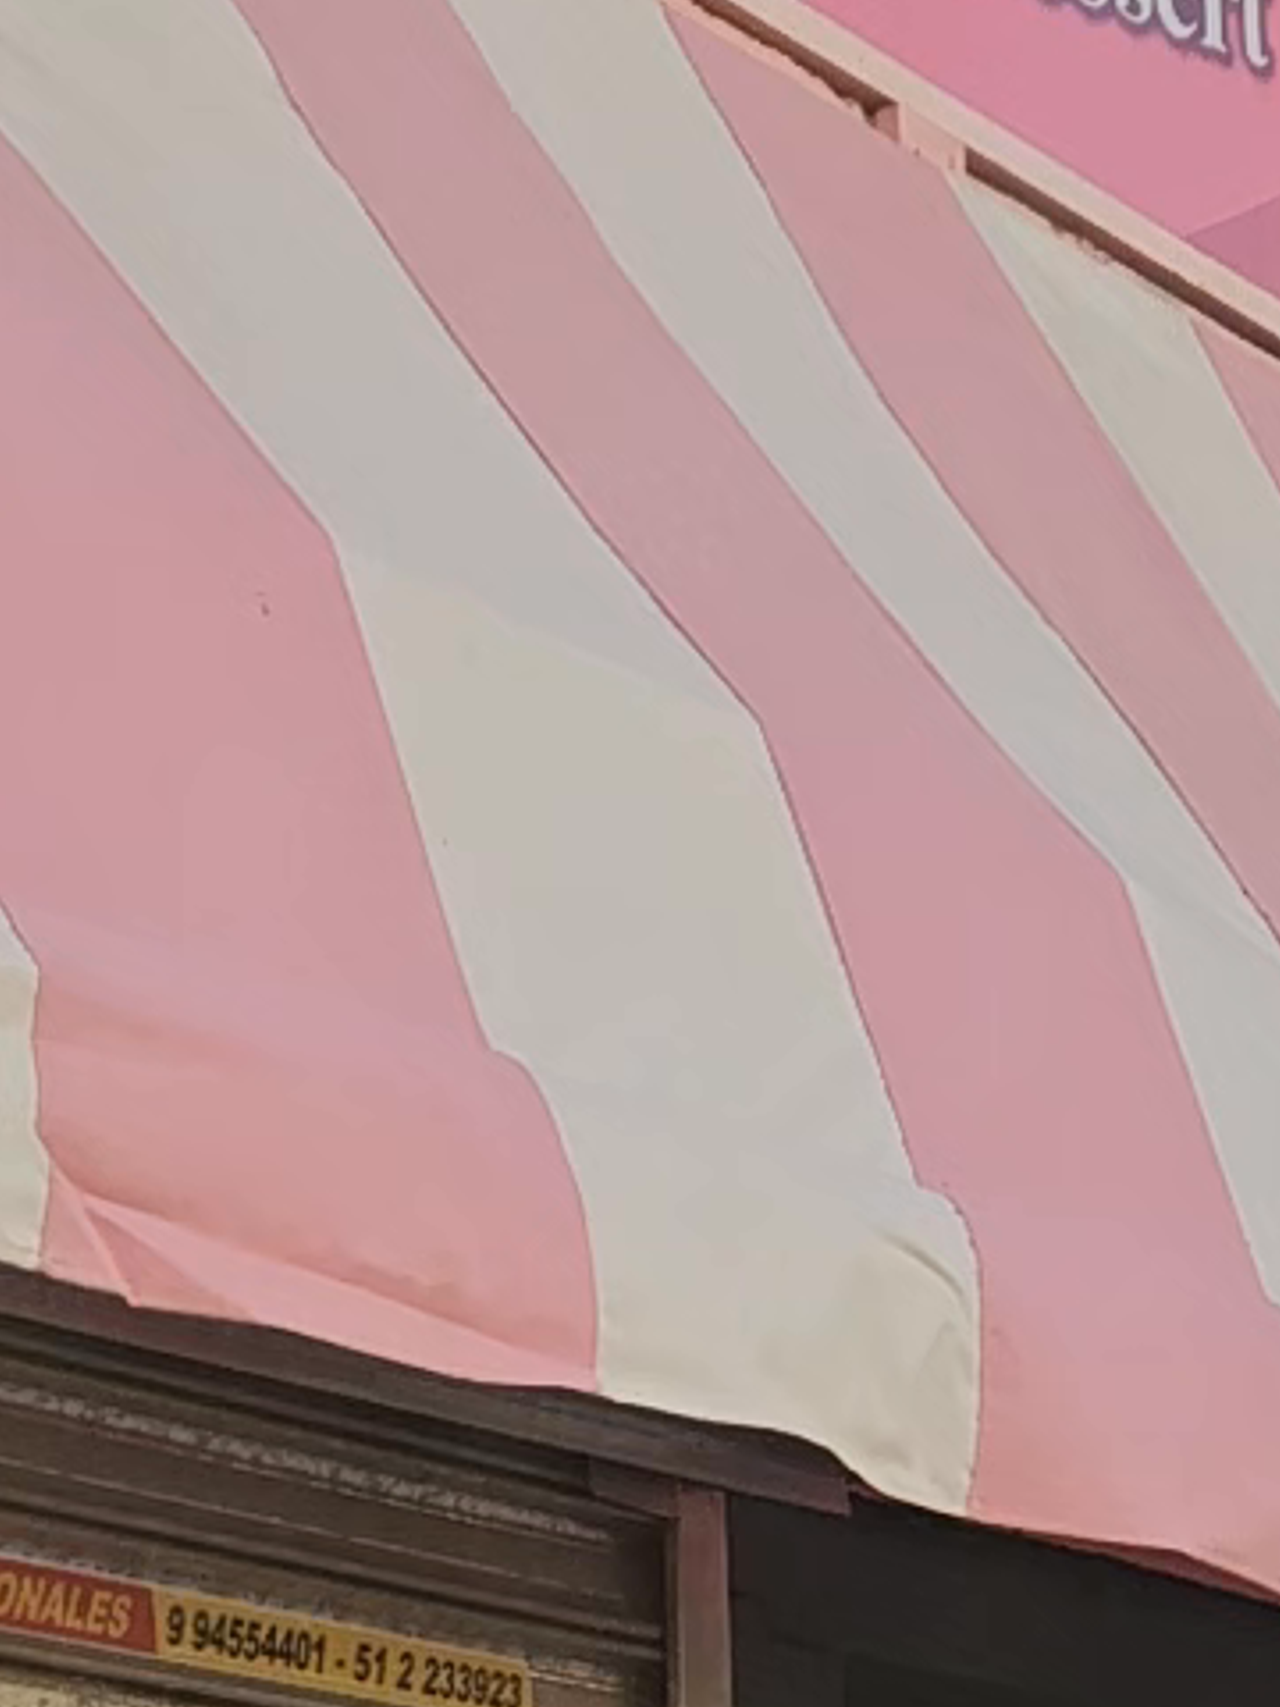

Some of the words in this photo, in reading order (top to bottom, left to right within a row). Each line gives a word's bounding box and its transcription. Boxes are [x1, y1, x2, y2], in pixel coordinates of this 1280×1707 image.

[166, 1605, 185, 1646] 9
[192, 1609, 326, 1674] 94554401
[353, 1643, 388, 1685] 51
[396, 1650, 415, 1691] 2
